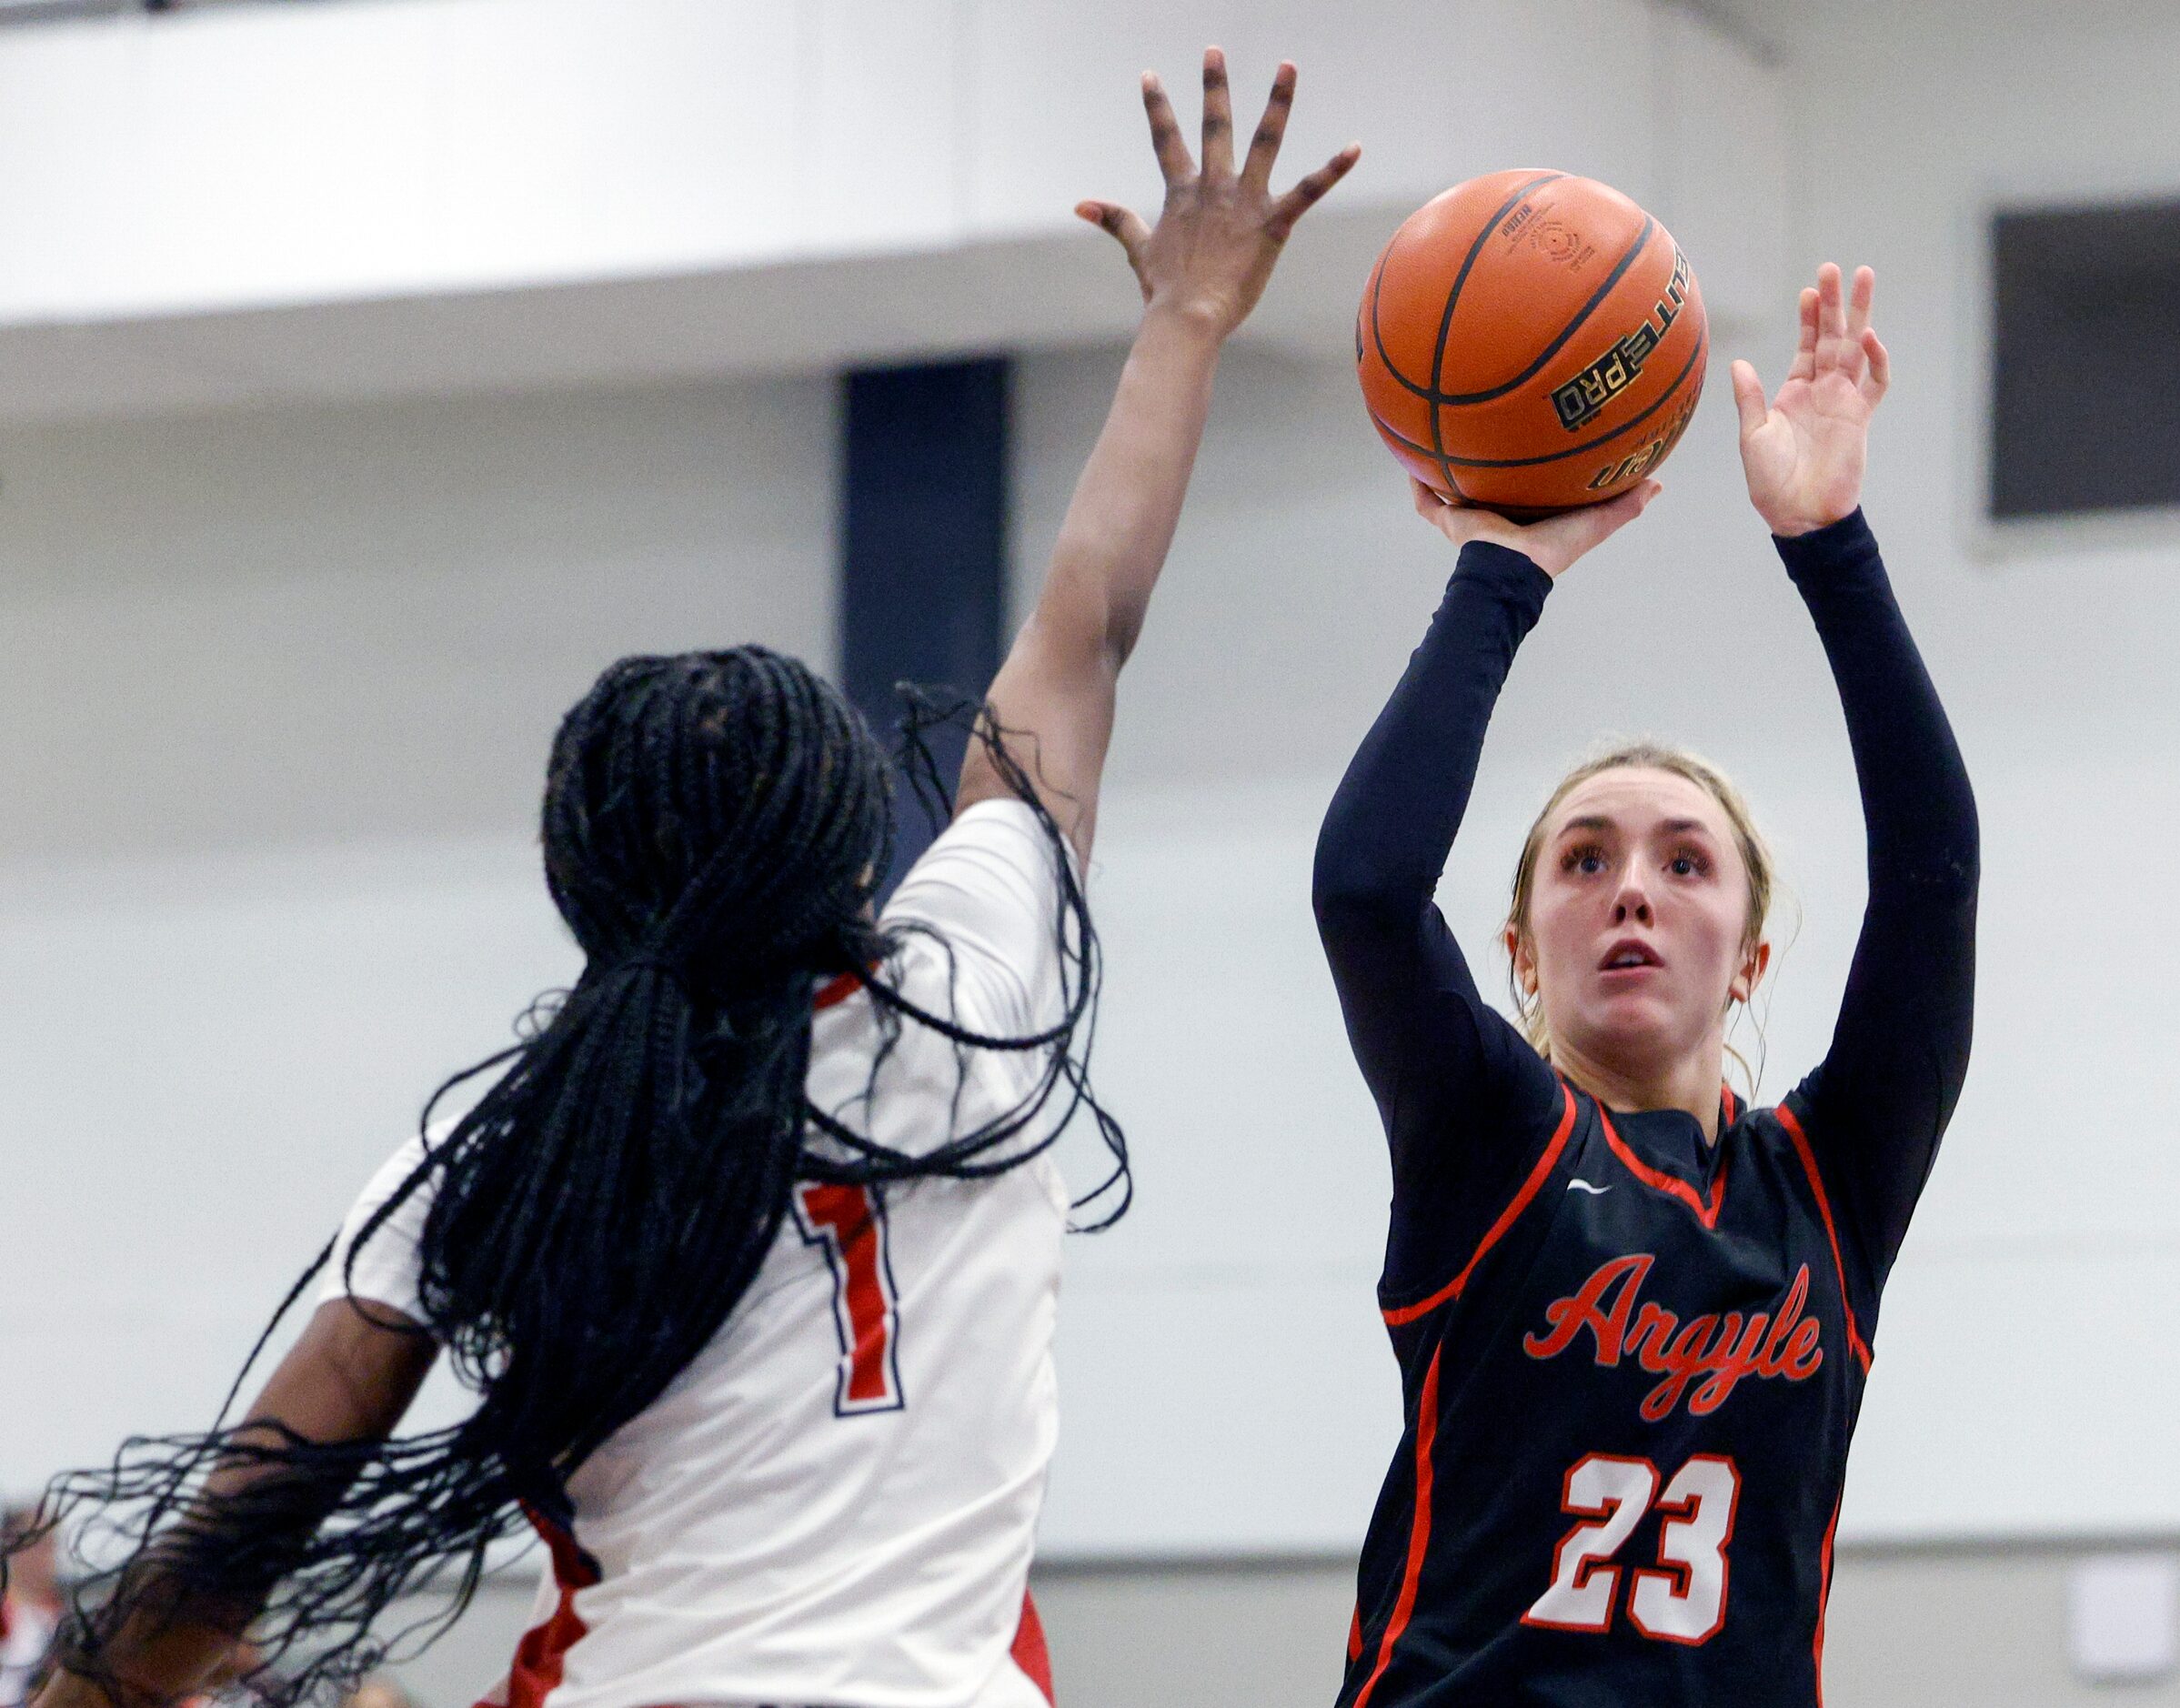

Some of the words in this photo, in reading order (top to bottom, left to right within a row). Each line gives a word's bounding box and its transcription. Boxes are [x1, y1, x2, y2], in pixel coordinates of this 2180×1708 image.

[1556, 349, 1629, 423] PRO
[1621, 244, 1691, 370] ELITE
[790, 1181, 905, 1420] 1
[1522, 1252, 1823, 1422] Argyle
[1520, 1452, 1743, 1647] 23
